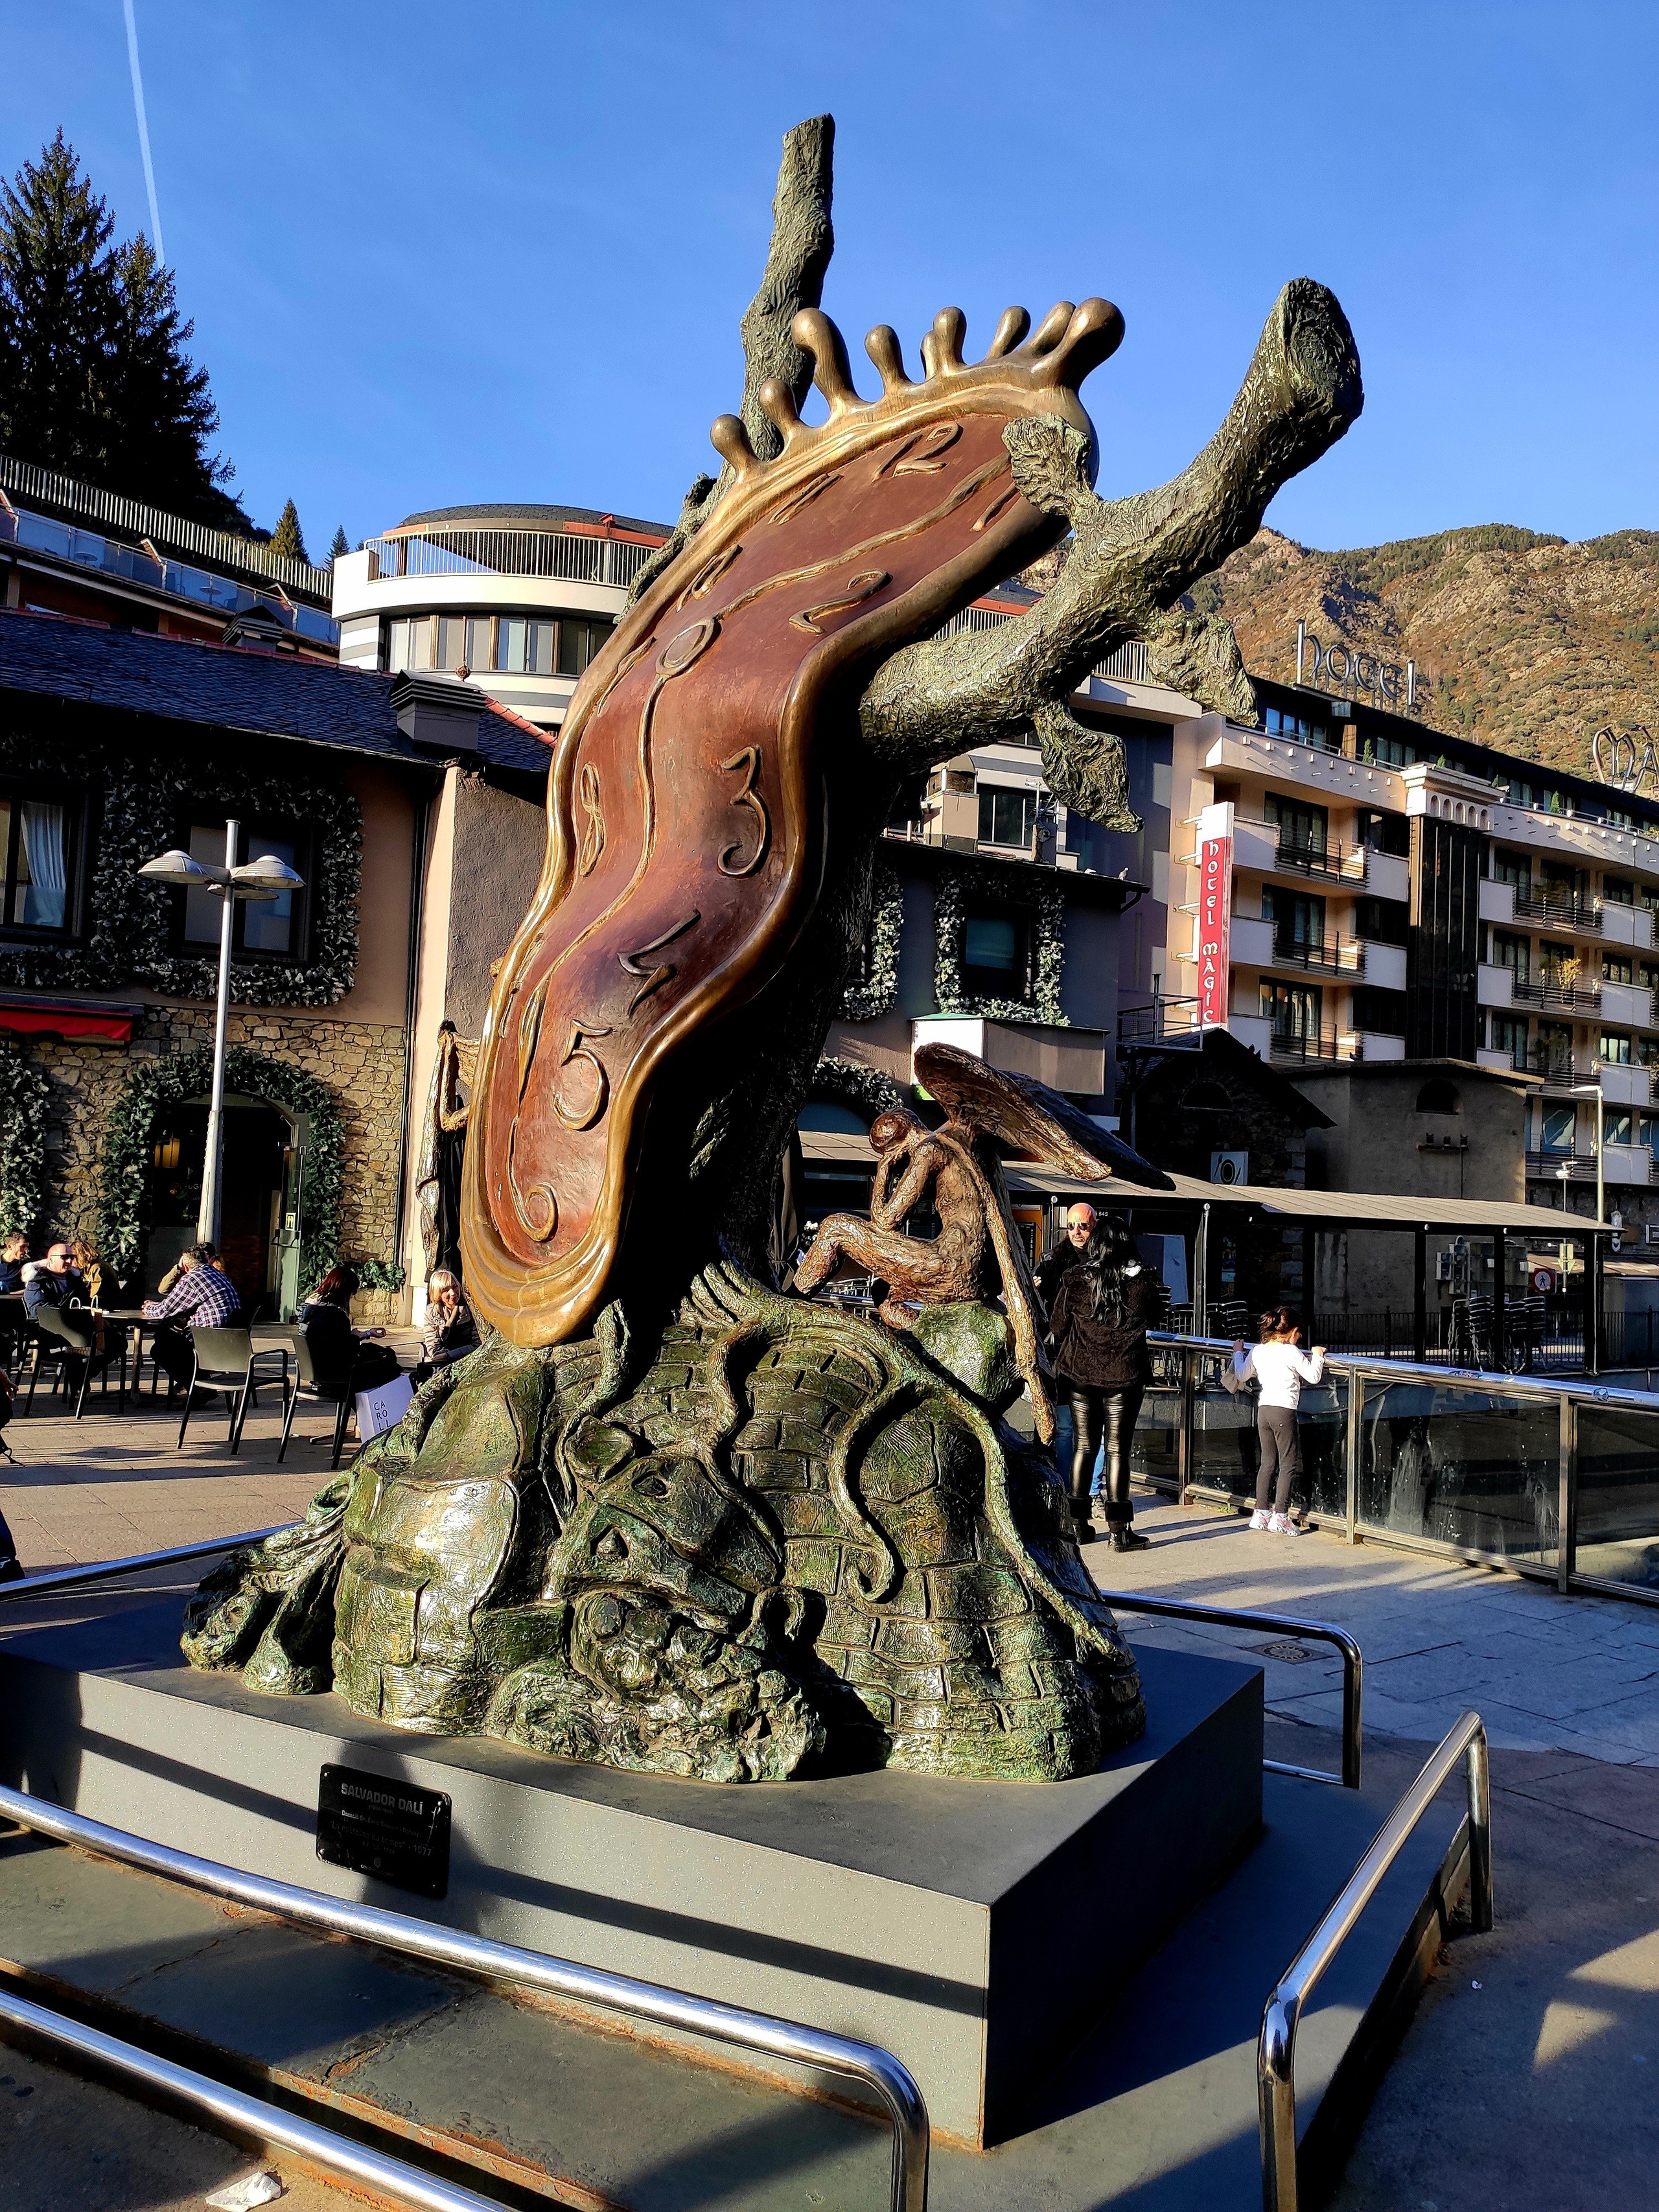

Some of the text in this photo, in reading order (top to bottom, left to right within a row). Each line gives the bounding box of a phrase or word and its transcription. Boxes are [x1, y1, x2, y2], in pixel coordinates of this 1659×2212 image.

[872, 421, 962, 482] 12
[789, 568, 892, 634] 2
[718, 744, 769, 876] 3
[553, 1019, 612, 1130] 5
[341, 1783, 423, 1815] SALVADOR DALÍ
[413, 1844, 432, 1857] 1977
